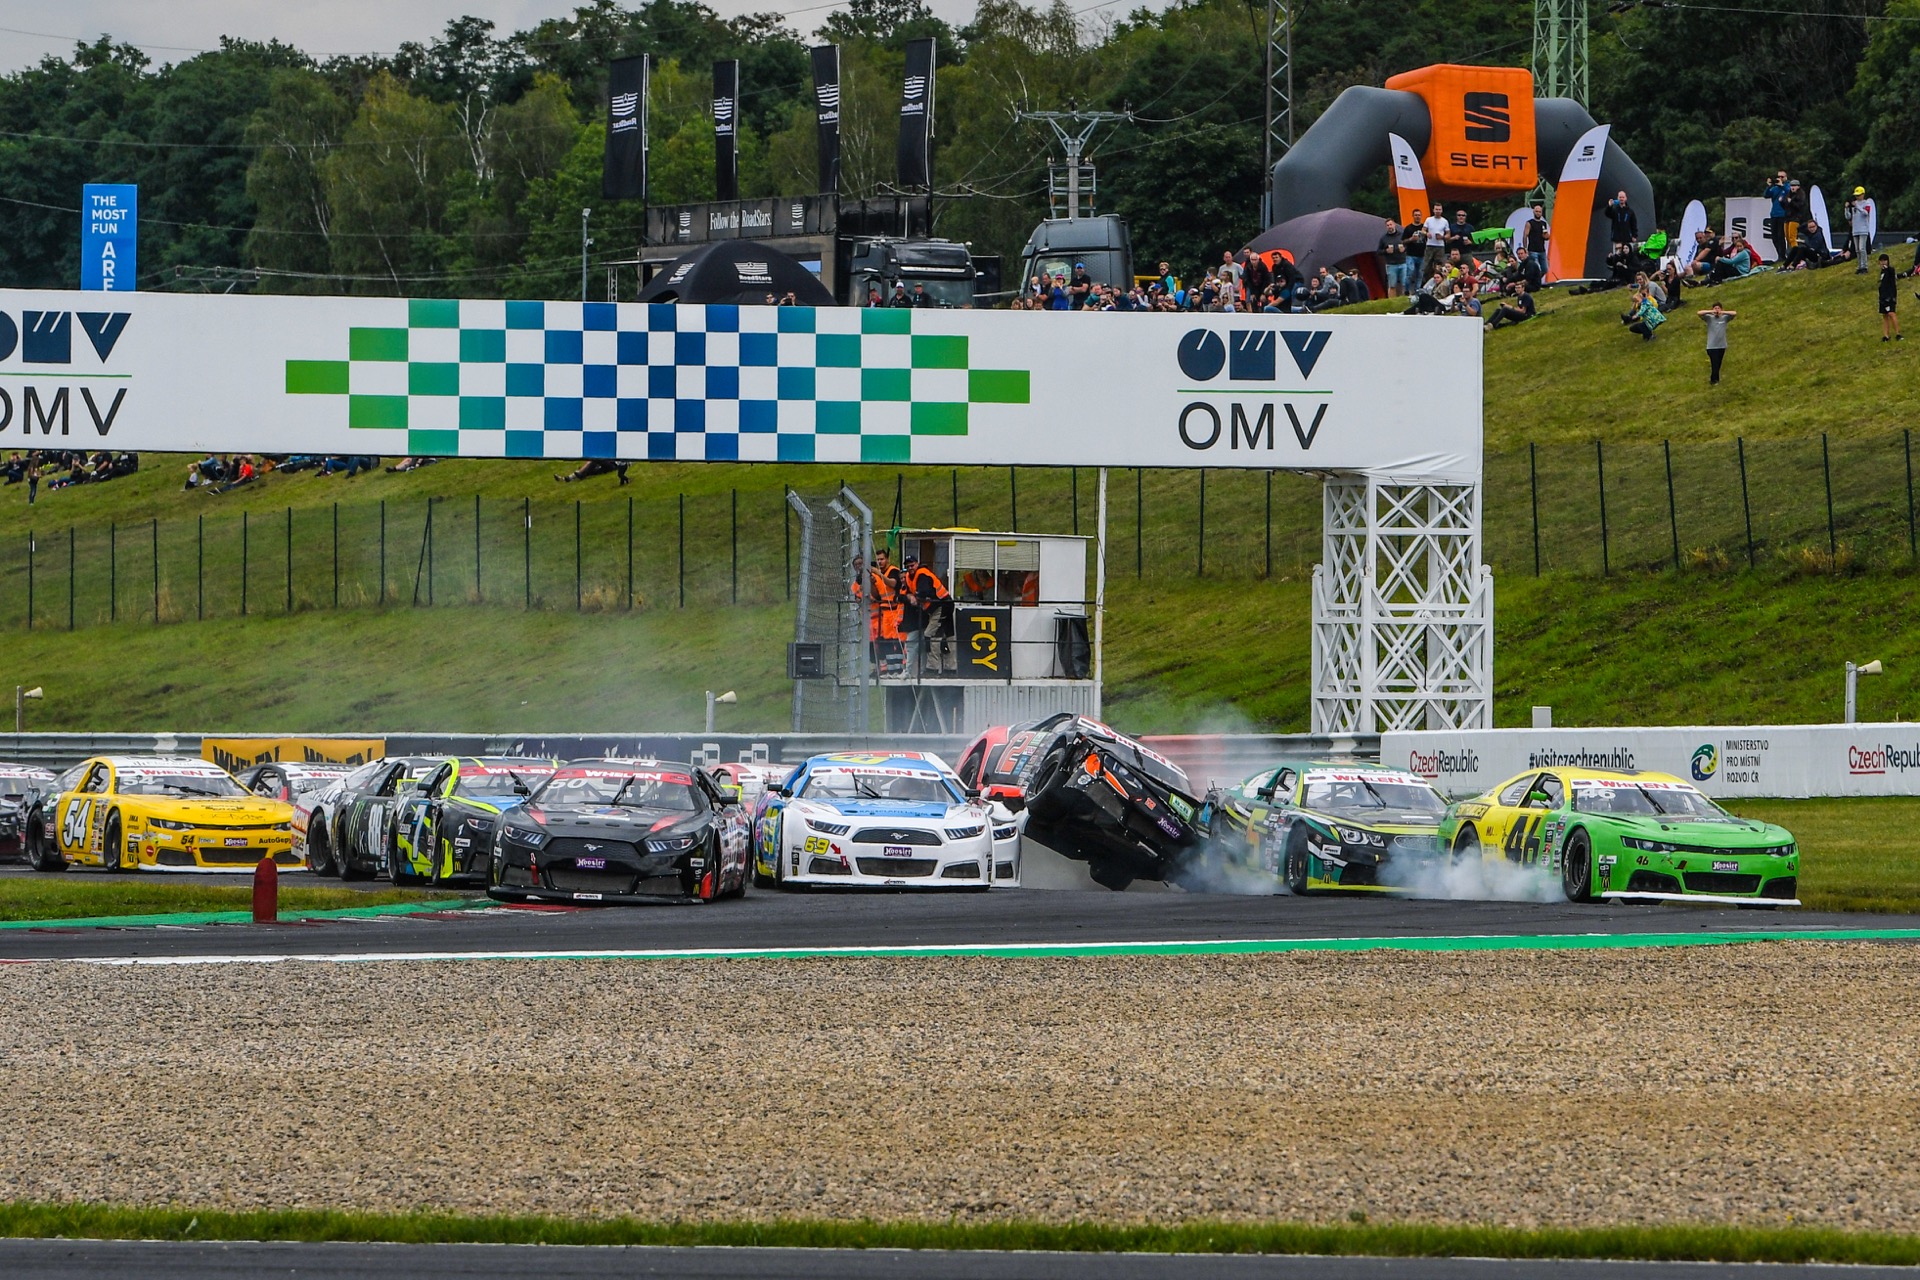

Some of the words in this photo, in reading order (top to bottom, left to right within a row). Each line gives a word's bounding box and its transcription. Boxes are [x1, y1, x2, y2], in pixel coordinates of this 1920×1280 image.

[1451, 152, 1528, 170] SEAT
[91, 195, 117, 206] THE
[91, 209, 128, 220] MOST
[710, 212, 729, 231] Follow
[730, 211, 740, 229] the
[741, 209, 773, 228] RoadStars.
[91, 223, 118, 234] FUN
[1178, 401, 1329, 450] OMV
[970, 616, 998, 671] FCY
[1726, 740, 1769, 751] MINISTERSTVO
[1410, 749, 1479, 776] CzechRepublic
[1726, 756, 1738, 767] PRO
[1740, 754, 1761, 767] MÍSTNÍ
[484, 766, 556, 774] WHELEN
[585, 769, 662, 780] WHELEN
[838, 767, 913, 776] WHELEN
[1332, 774, 1404, 783] WHELEN
[1726, 772, 1750, 783] ROZVOJ
[1751, 770, 1760, 783] ČR
[550, 778, 586, 789] 50
[1597, 780, 1669, 789] WHELEN
[1577, 789, 1616, 799] 46
[63, 798, 91, 848] 54
[1158, 818, 1181, 838] Hoosier
[181, 835, 195, 845] 54
[804, 836, 829, 855] 69
[1505, 815, 1542, 868] 46
[884, 847, 911, 857] Hoosier
[577, 858, 605, 867] Hoosier
[1636, 855, 1649, 866] 46
[1713, 862, 1738, 870] Hoosier
[1786, 861, 1795, 871] 46
